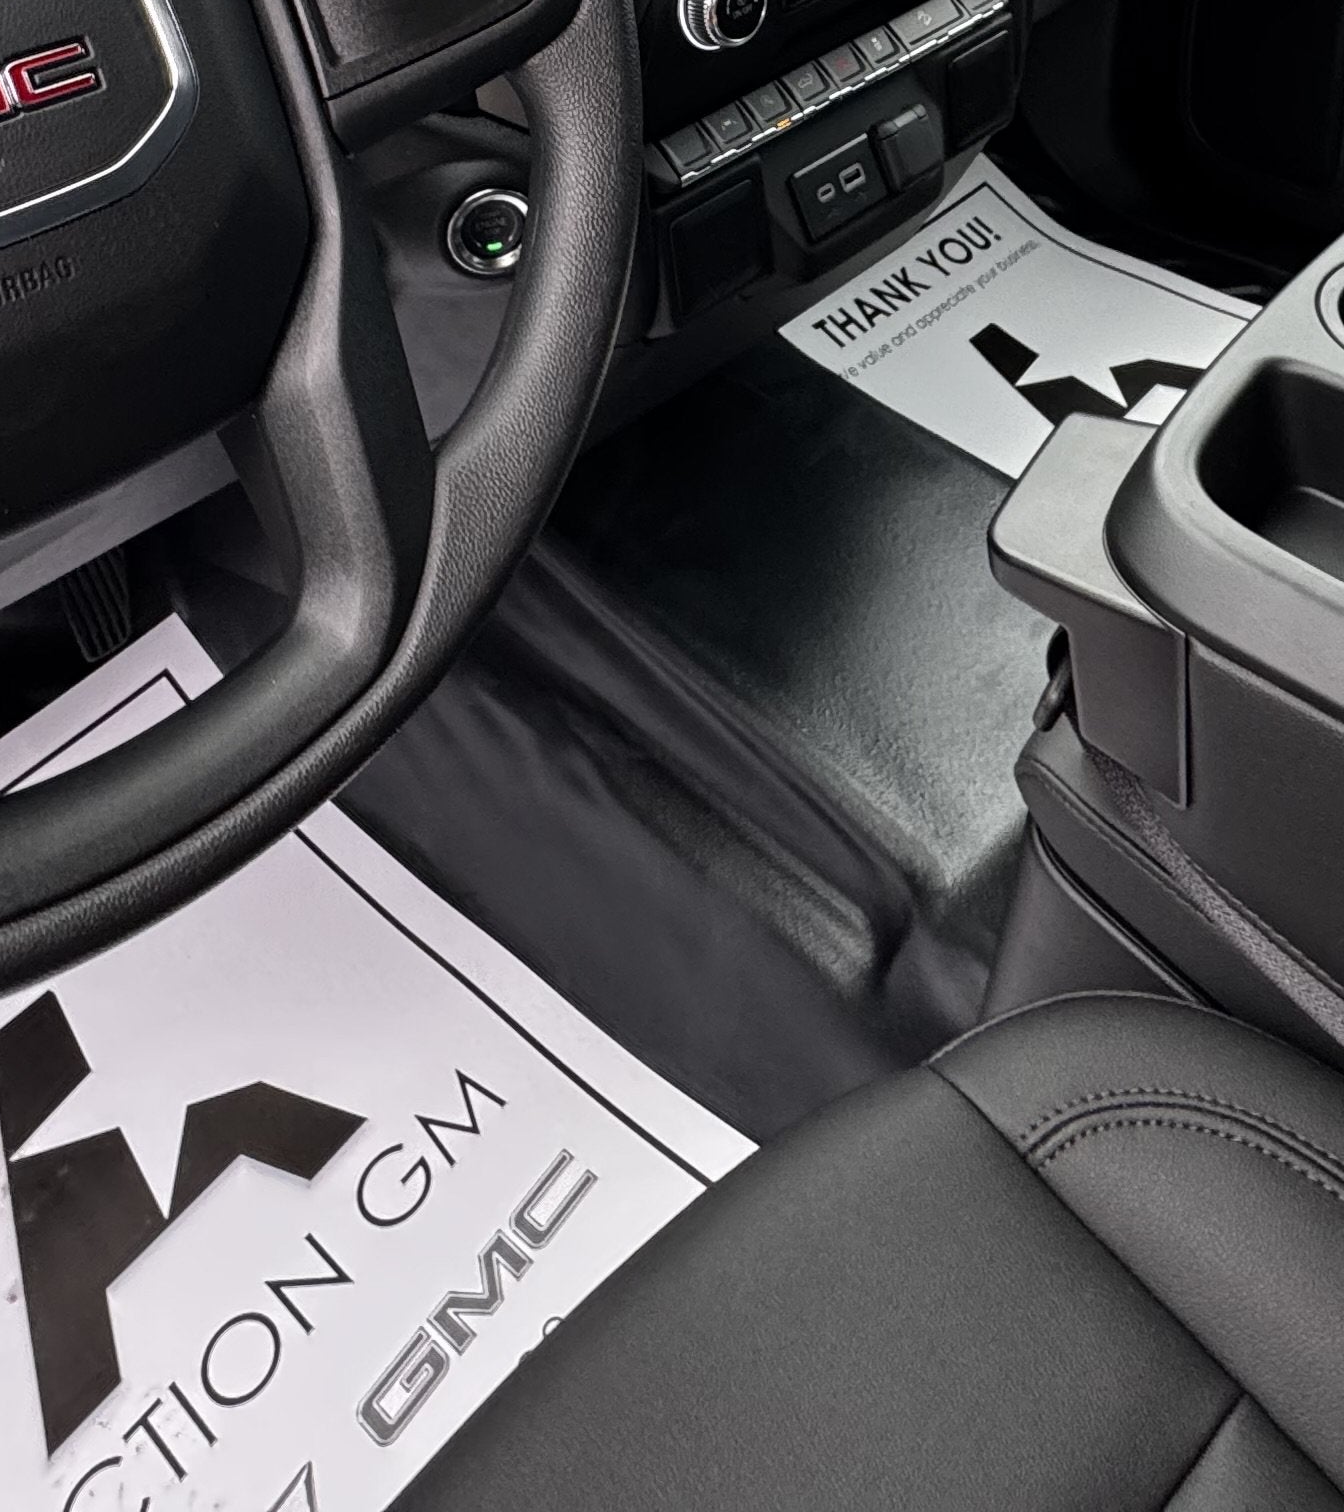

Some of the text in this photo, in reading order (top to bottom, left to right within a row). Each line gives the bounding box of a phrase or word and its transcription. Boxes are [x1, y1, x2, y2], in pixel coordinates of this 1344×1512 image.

[811, 216, 1003, 349] THANK YOU!
[858, 341, 893, 369] value
[891, 324, 918, 346] and
[356, 1067, 507, 1228] GM
[356, 1148, 599, 1448] GMC
